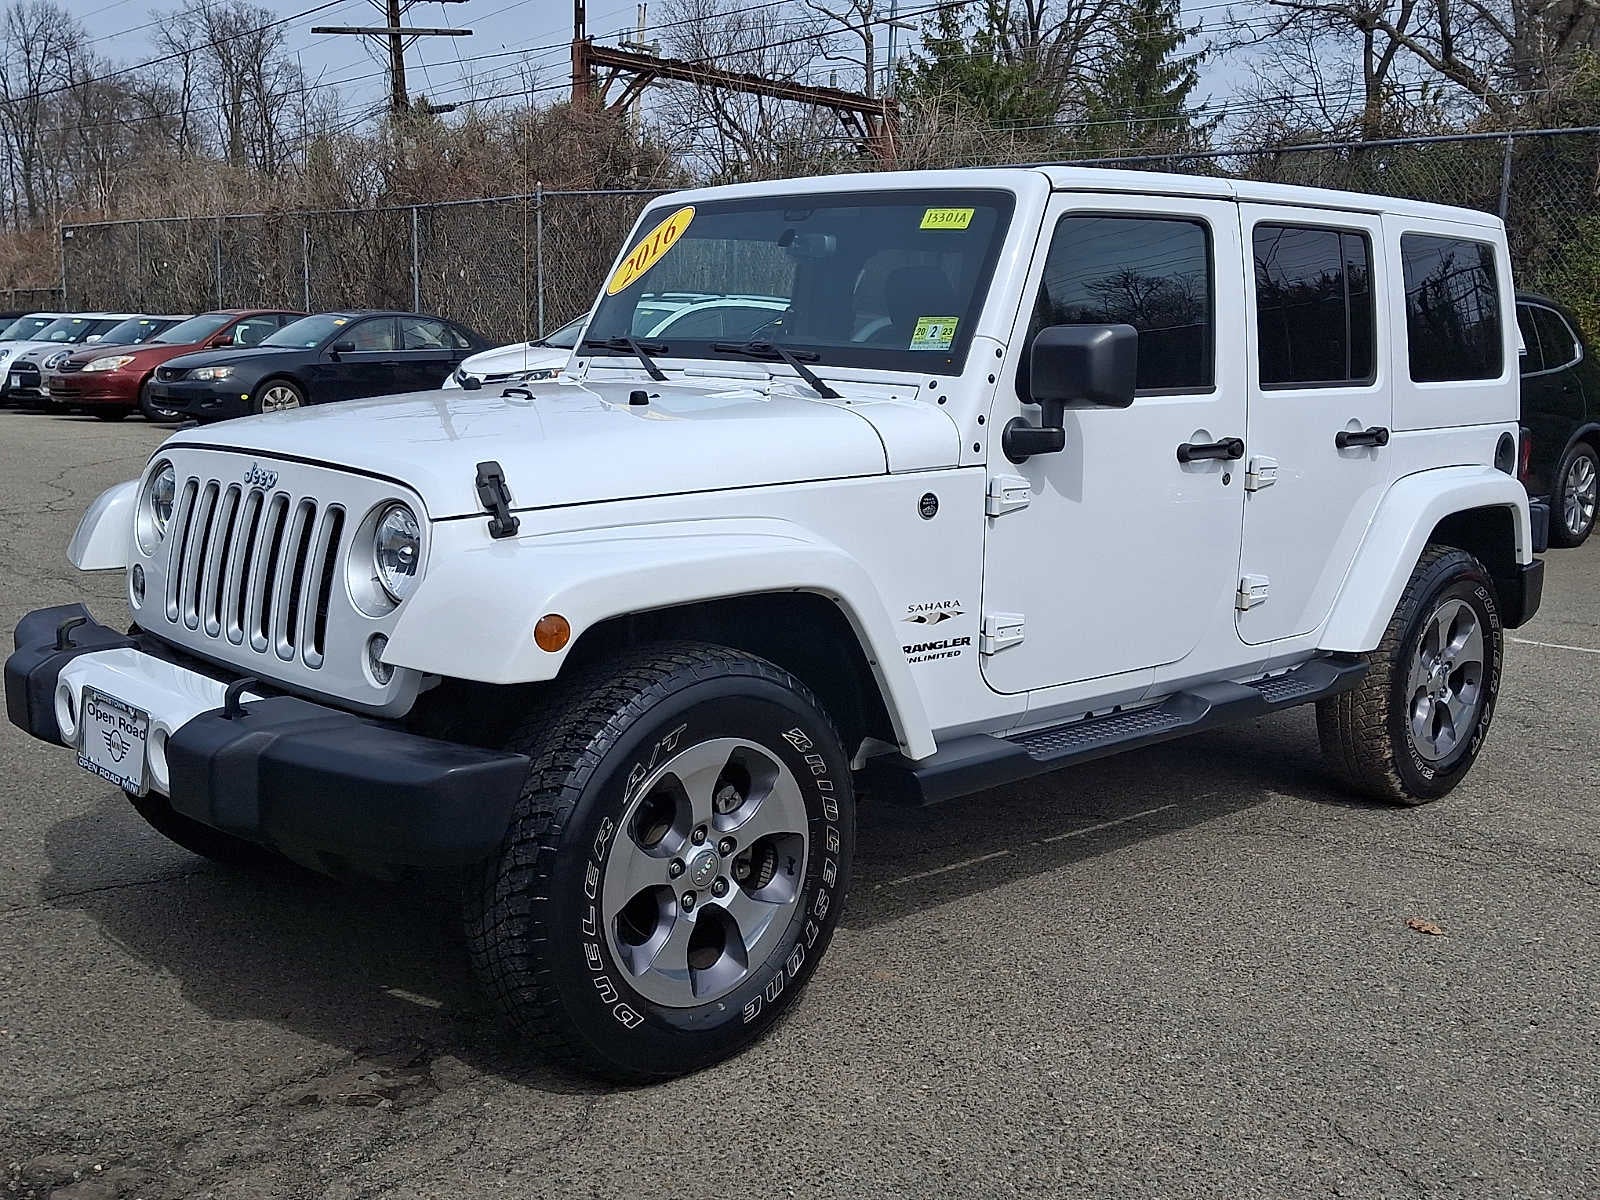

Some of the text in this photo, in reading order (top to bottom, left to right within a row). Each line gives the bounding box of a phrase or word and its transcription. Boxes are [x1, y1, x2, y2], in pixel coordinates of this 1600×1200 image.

[621, 214, 679, 287] 2016
[915, 325, 953, 338] 20 2 23
[244, 462, 278, 491] Jeep
[907, 599, 961, 613] SAHARA
[902, 636, 971, 654] RANGLER
[906, 650, 961, 664] NLIMITED
[87, 702, 115, 726] Open
[119, 716, 146, 741] Road
[78, 757, 140, 794] OPEN ROAD MINI
[582, 723, 688, 1029] DUELER A/T
[742, 727, 840, 1024] BRIDGESTONE
